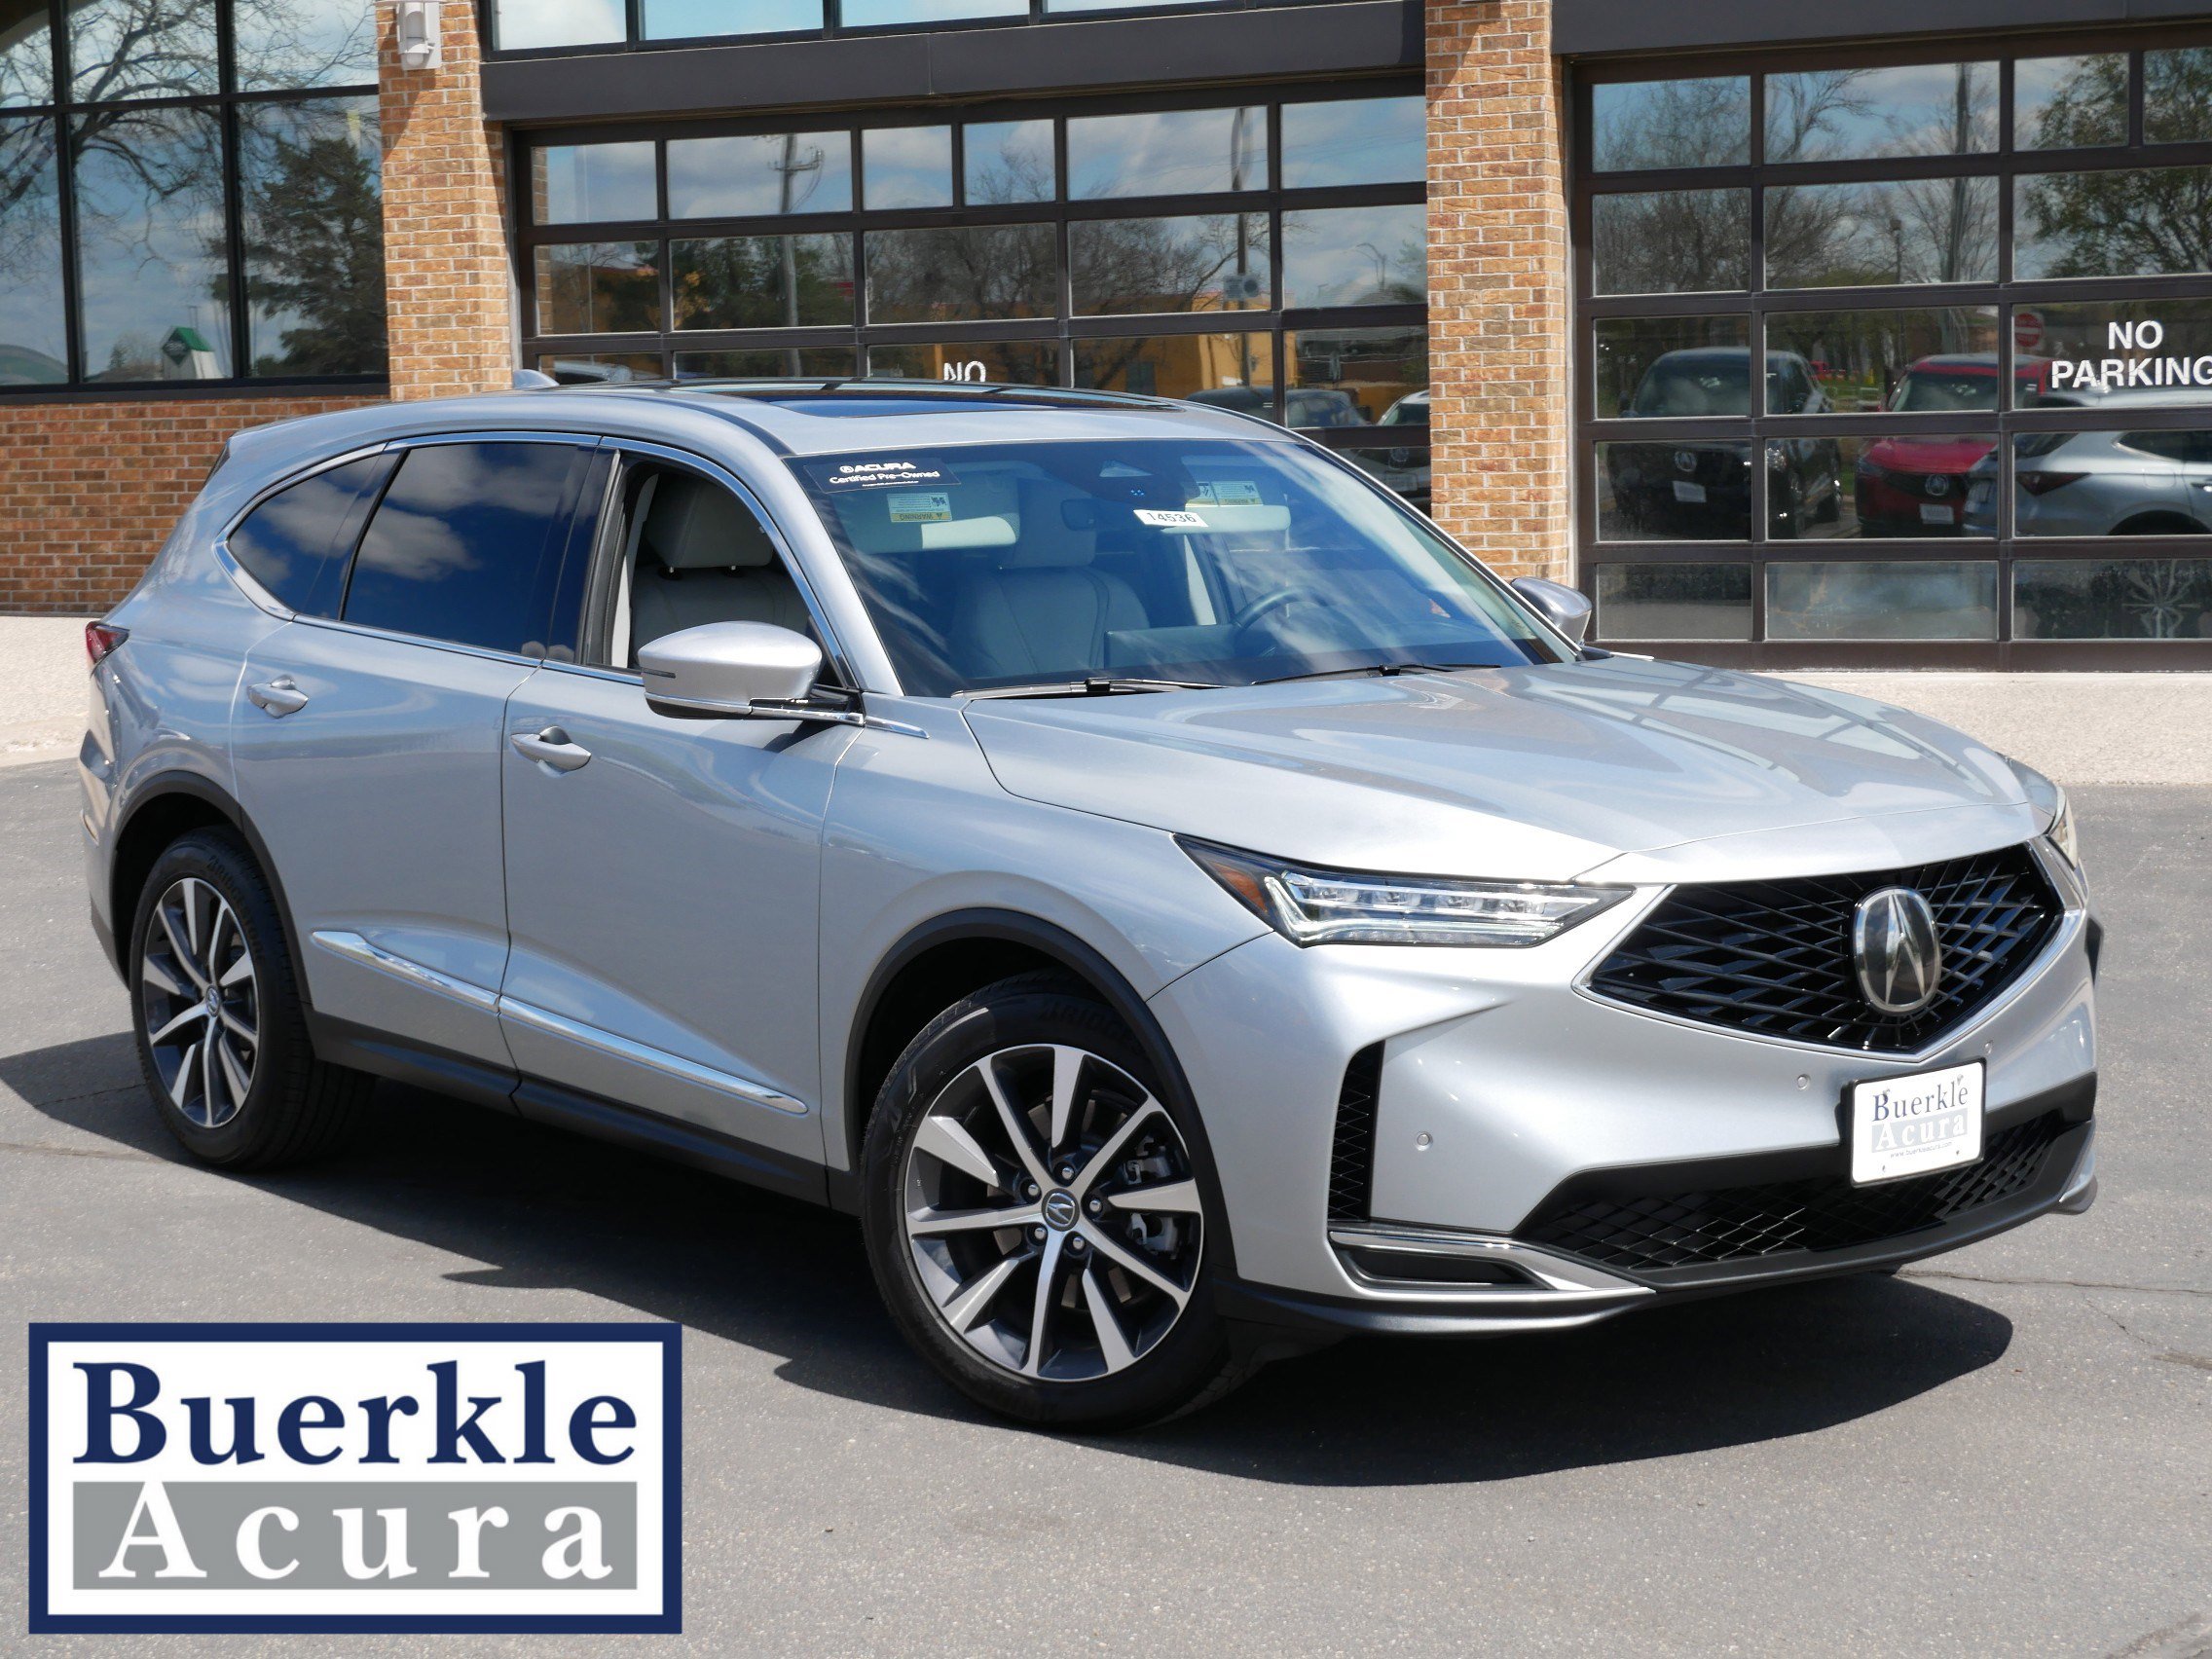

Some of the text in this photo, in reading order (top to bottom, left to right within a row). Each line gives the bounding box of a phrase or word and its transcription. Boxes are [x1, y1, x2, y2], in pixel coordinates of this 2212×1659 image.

[2108, 320, 2164, 350] NO
[2051, 355, 2212, 389] PARKING
[830, 474, 876, 484] Certified
[877, 471, 940, 480] Pre-Owned
[855, 462, 916, 472] ACURA
[1146, 511, 1198, 523] 14536
[1872, 1080, 1968, 1122] Buerkle
[1875, 1114, 1965, 1150] Acura
